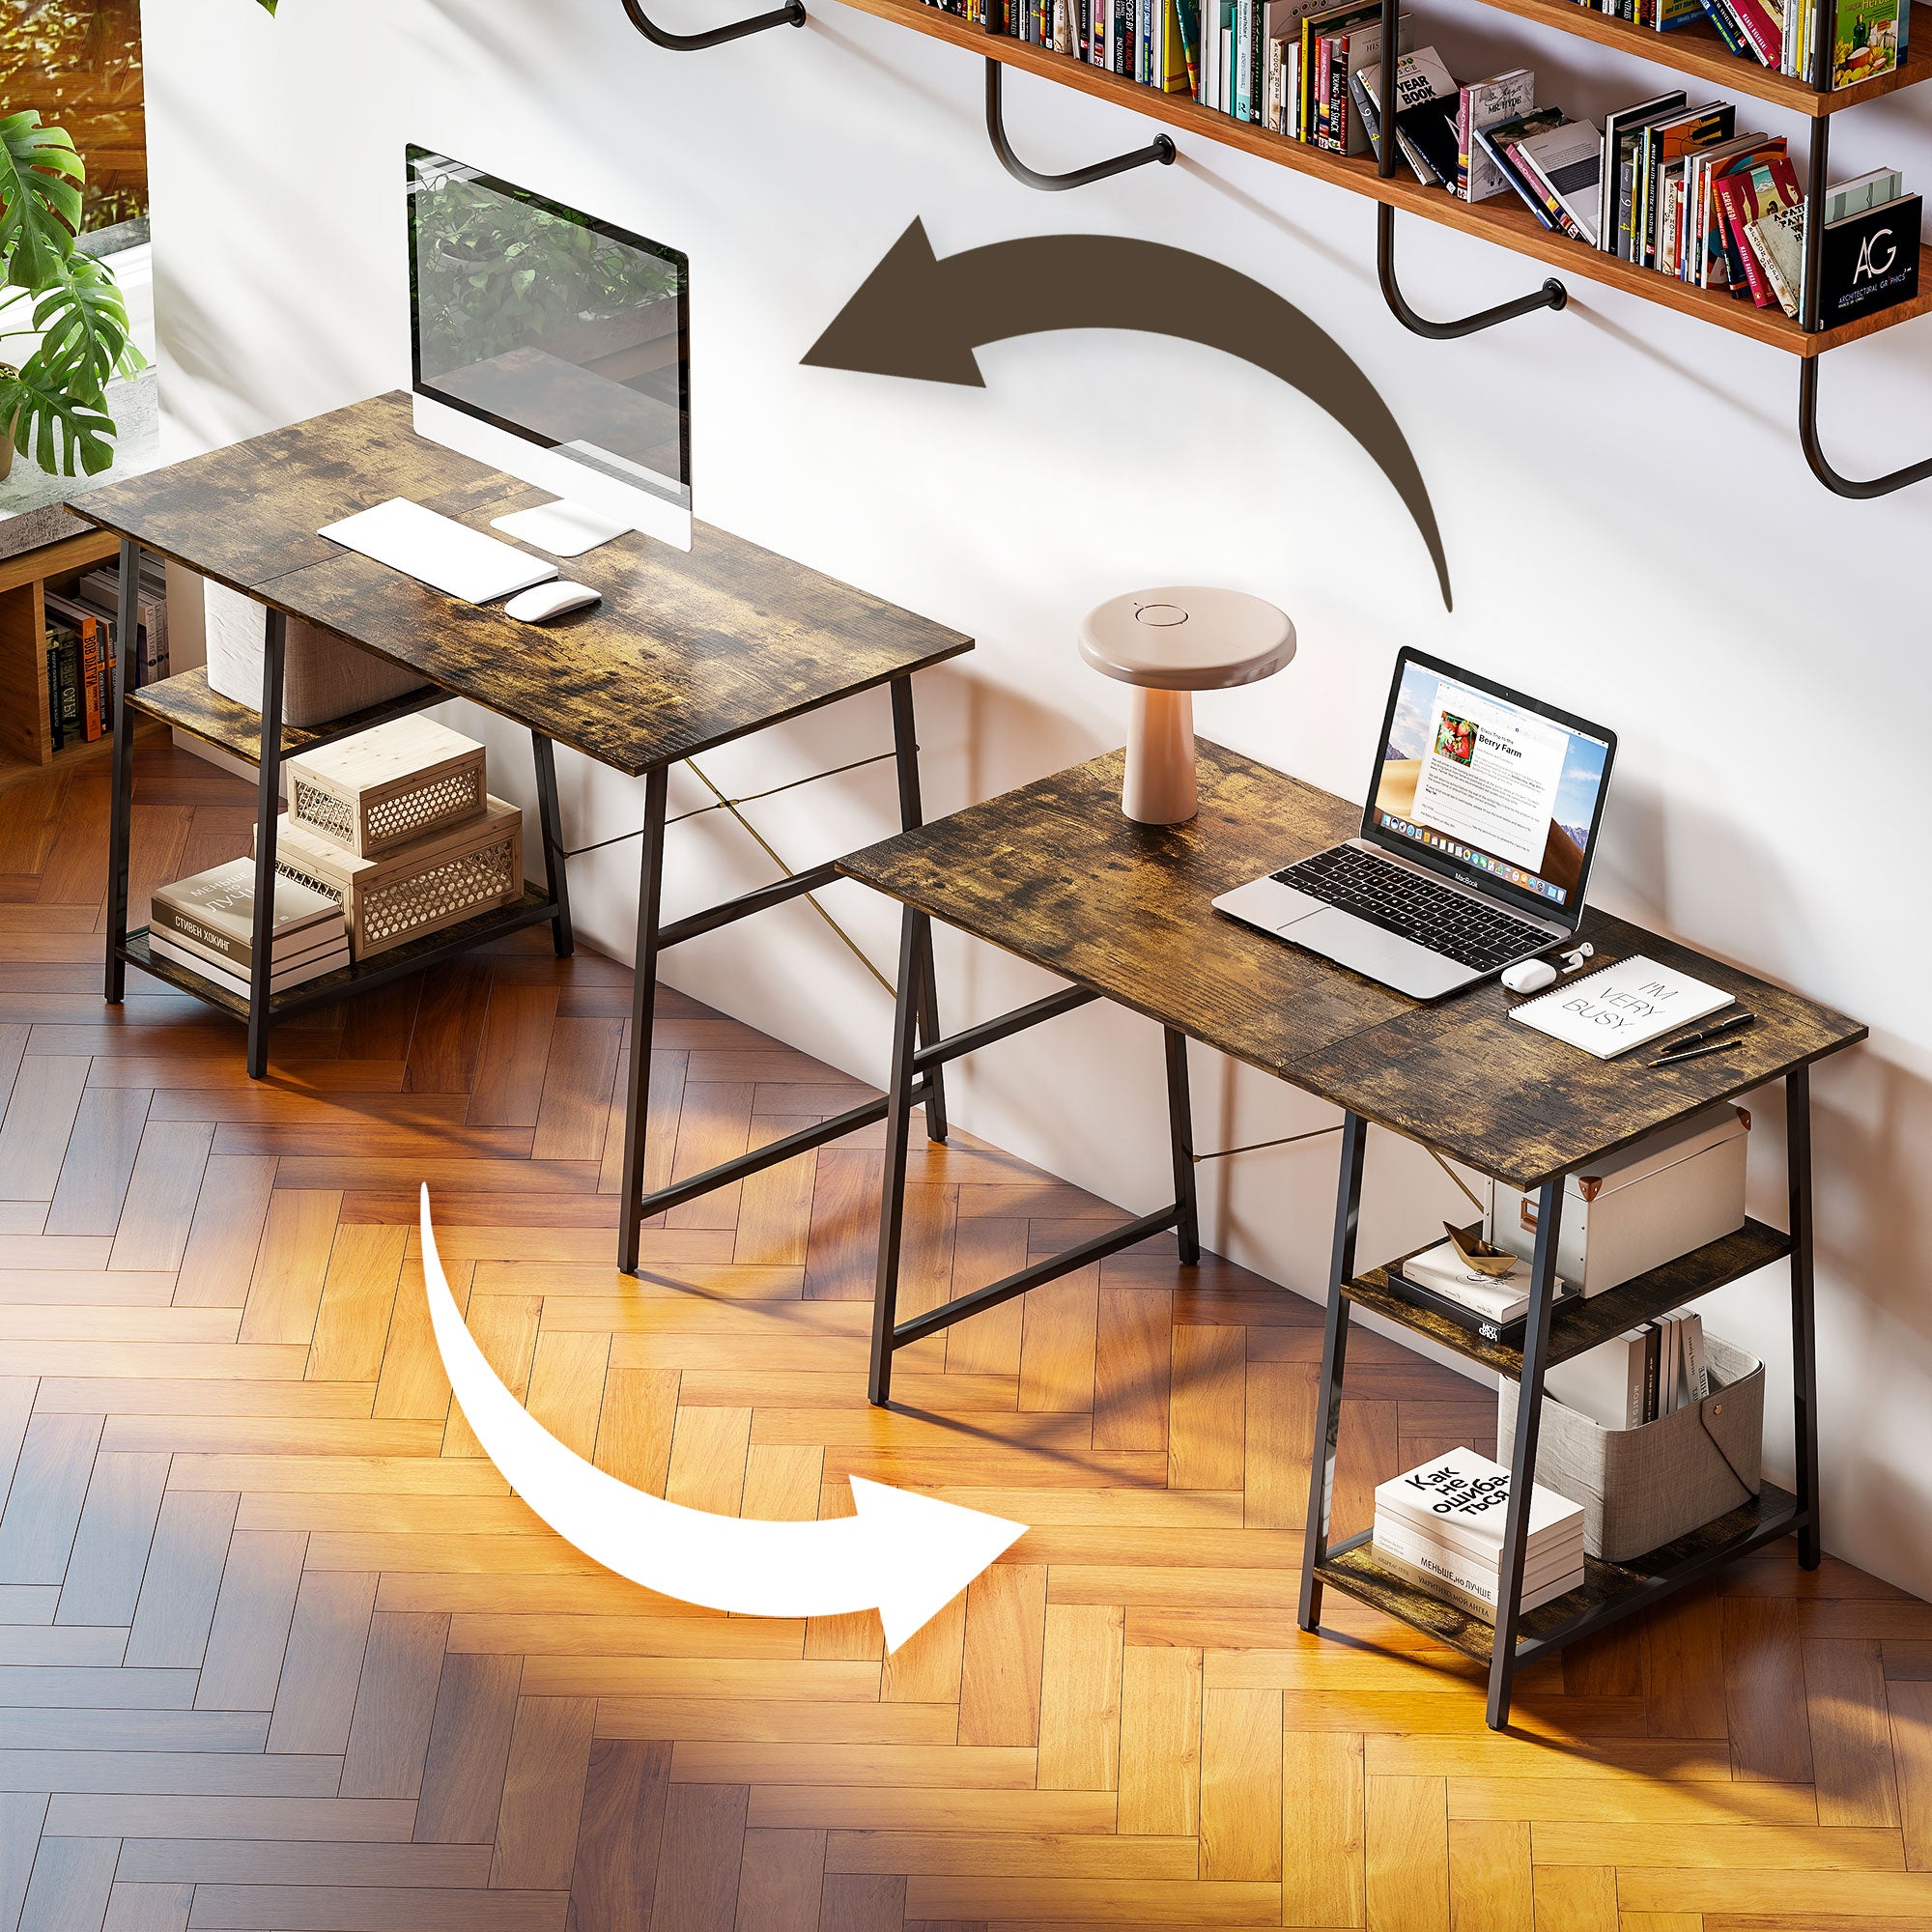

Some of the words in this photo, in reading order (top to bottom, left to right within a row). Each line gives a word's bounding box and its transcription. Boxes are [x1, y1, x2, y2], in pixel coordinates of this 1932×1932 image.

[1125, 19, 1134, 32] BY
[1124, 30, 1133, 47] REAL
[1124, 48, 1134, 72] MOMS
[1397, 74, 1430, 94] YEAR
[1402, 85, 1437, 105] BOOK
[1331, 98, 1340, 112] THE
[1501, 95, 1522, 110] HYDE
[1330, 110, 1341, 133] SHACK
[1747, 227, 1767, 257] BEACON
[1852, 228, 1897, 285] AG
[1766, 258, 1779, 281] HOPE
[1838, 284, 1878, 304] ARCHITECTURAL
[1879, 272, 1906, 289] GRPHICS
[1478, 734, 1500, 751] Berry
[1501, 744, 1522, 758] Farm
[1492, 732, 1502, 741] Trip
[222, 884, 241, 894] НО
[1454, 872, 1479, 889] MacBook
[174, 916, 204, 937] СТИВЕН
[203, 929, 231, 952] ХОКИНГ
[1600, 986, 1665, 1018] VERY
[1638, 980, 1679, 1001] I'M
[1561, 998, 1636, 1035] BUSY.
[1405, 1466, 1461, 1492] Как
[1435, 1478, 1469, 1496] не
[1432, 1474, 1511, 1514] ошиба-
[1458, 1490, 1510, 1516] ться
[1455, 1576, 1465, 1586] но
[1464, 1579, 1492, 1600] ЛУЧШЕ
[1453, 1593, 1468, 1607] МОЙ
[1468, 1602, 1490, 1617] АНГЕЛ
